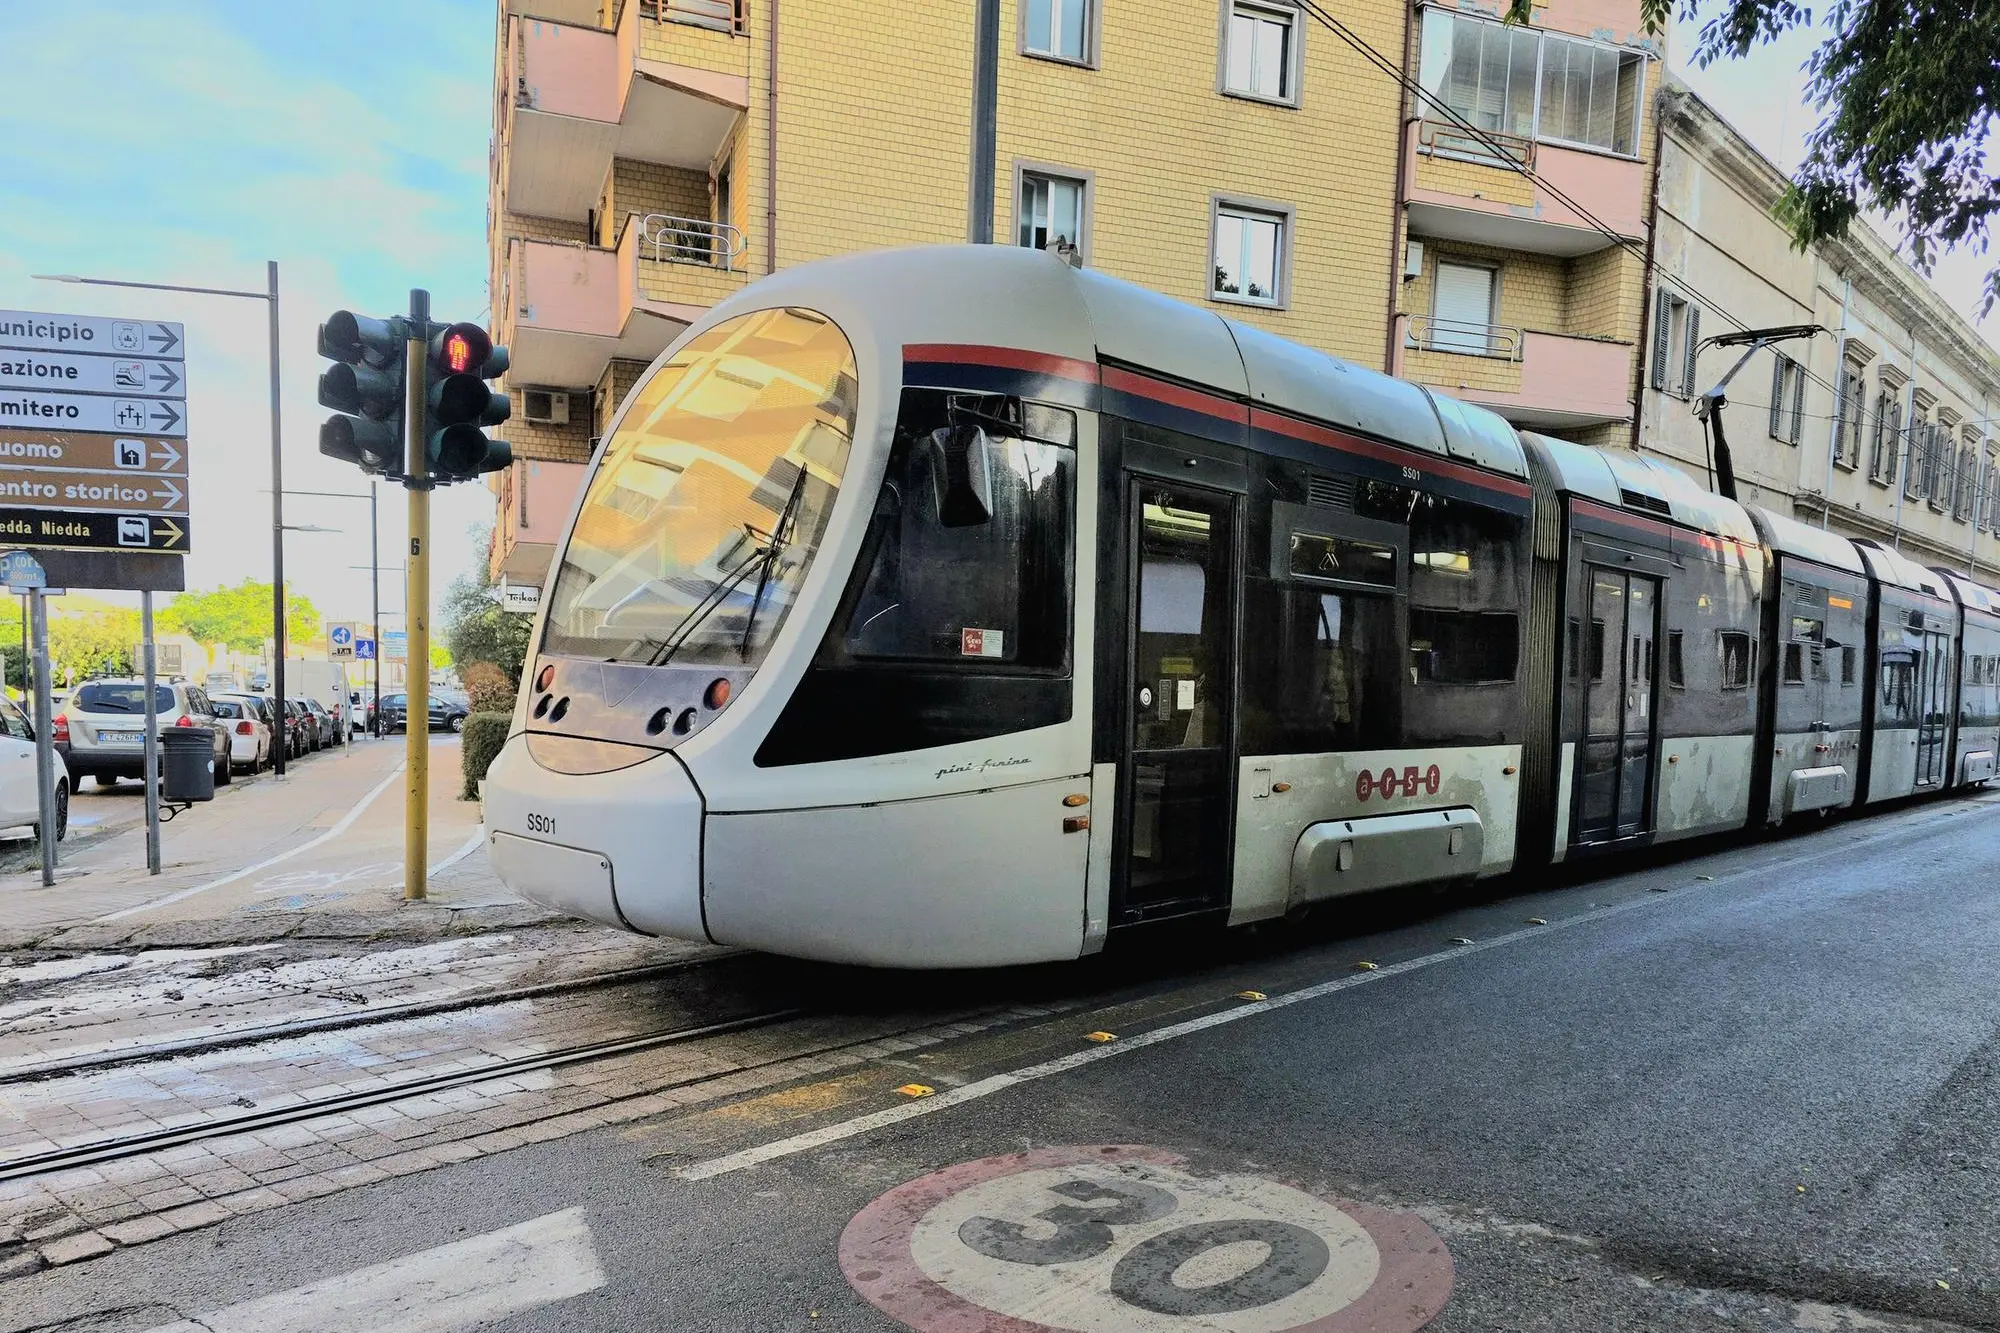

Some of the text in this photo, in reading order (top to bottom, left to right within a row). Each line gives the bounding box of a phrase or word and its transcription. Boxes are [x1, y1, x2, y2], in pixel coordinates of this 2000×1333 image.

[0, 359, 78, 379] azione
[1, 398, 79, 418] mitero
[1402, 466, 1420, 481] SS01
[64, 483, 148, 502] storico
[41, 521, 90, 537] Niedda
[410, 537, 420, 556] 6
[1358, 768, 1437, 797] arst
[527, 812, 556, 835] SS01
[957, 1179, 1330, 1316] 30
